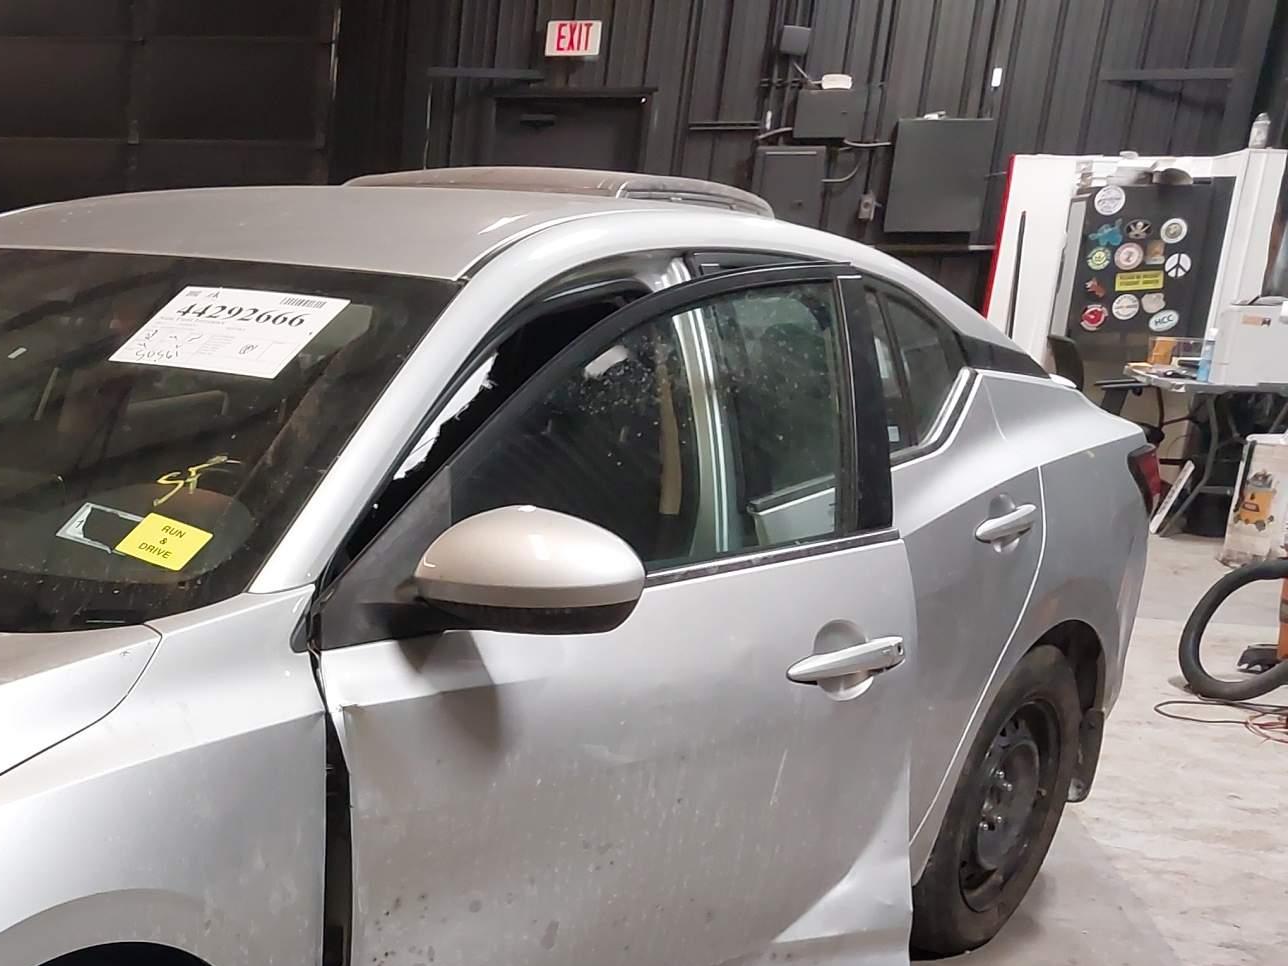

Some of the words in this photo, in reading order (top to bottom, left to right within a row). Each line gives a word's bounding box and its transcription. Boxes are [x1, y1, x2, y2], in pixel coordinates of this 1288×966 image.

[556, 22, 594, 51] EXIT
[175, 302, 309, 328] 44292666
[1154, 313, 1175, 326] HCC
[160, 525, 187, 539] RUN
[159, 537, 168, 545] &
[137, 542, 173, 559] DRIVE
